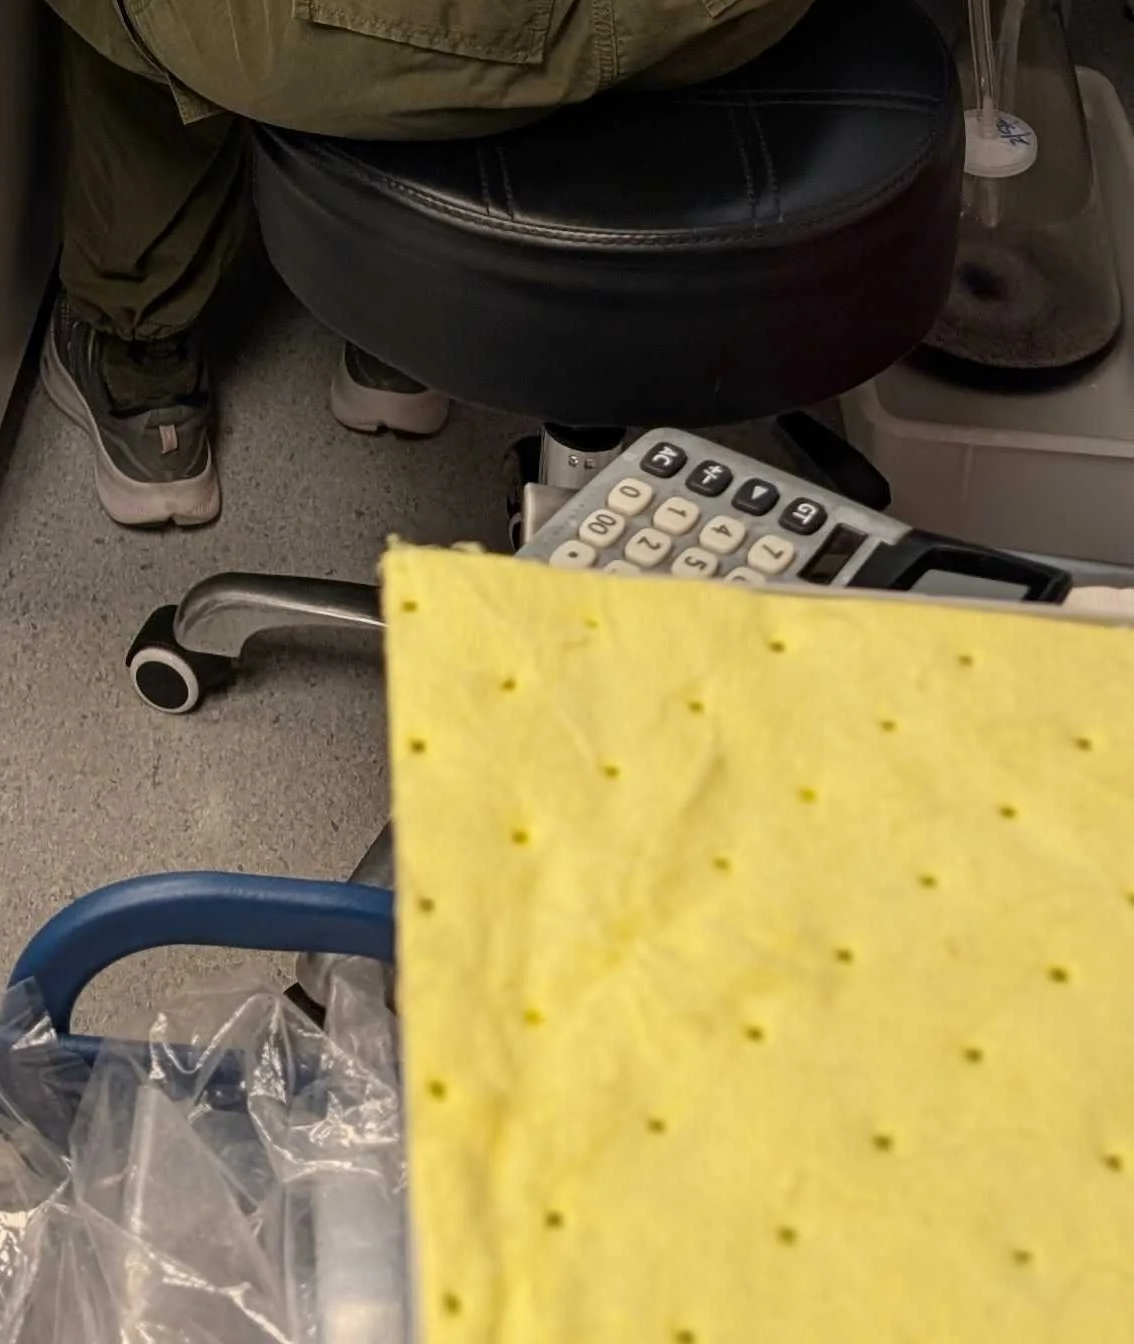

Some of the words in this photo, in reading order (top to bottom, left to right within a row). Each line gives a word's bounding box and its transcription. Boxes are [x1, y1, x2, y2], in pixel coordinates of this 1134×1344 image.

[653, 446, 678, 467] AC
[619, 486, 640, 498] 0
[667, 507, 687, 519] 1
[792, 504, 817, 525] GT
[588, 514, 617, 536] 00
[712, 524, 733, 537] 4
[639, 536, 661, 551] 2
[762, 545, 785, 561] 7
[684, 557, 706, 571] 5
